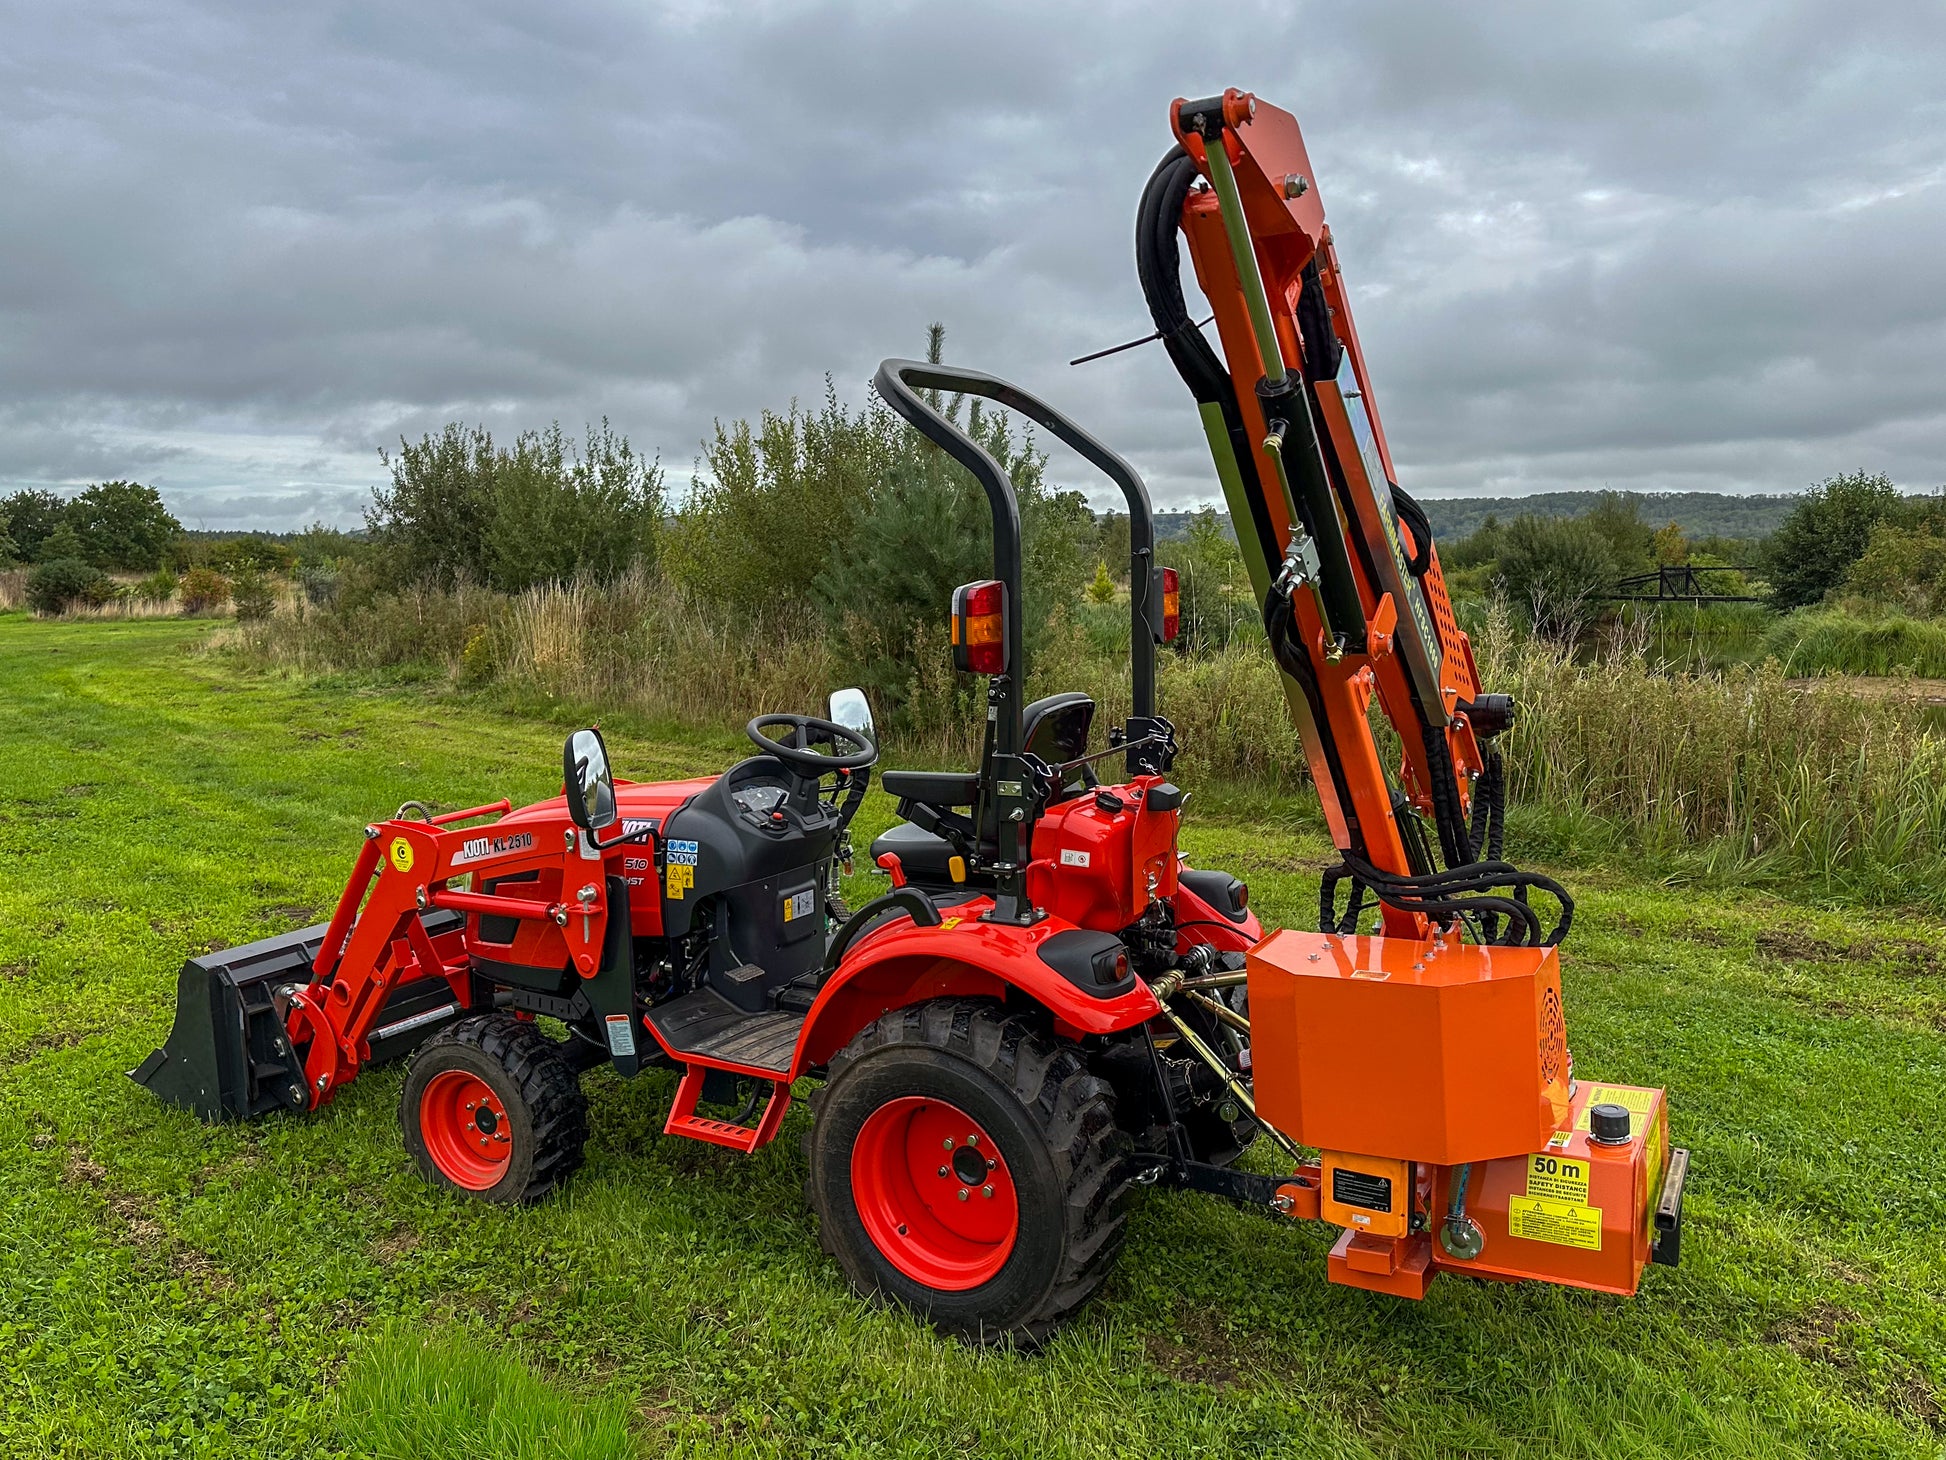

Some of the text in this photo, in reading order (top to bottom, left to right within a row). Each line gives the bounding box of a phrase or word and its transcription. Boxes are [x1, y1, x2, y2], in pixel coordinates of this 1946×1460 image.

[463, 832, 532, 859] KIOTI KL 2510
[625, 858, 648, 870] 510
[1534, 1157, 1580, 1178] 50 m
[1529, 1174, 1553, 1182] DISTANZA
[1560, 1179, 1587, 1187] SICUREZZA
[1529, 1180, 1587, 1193] SAFETY DISTANCE
